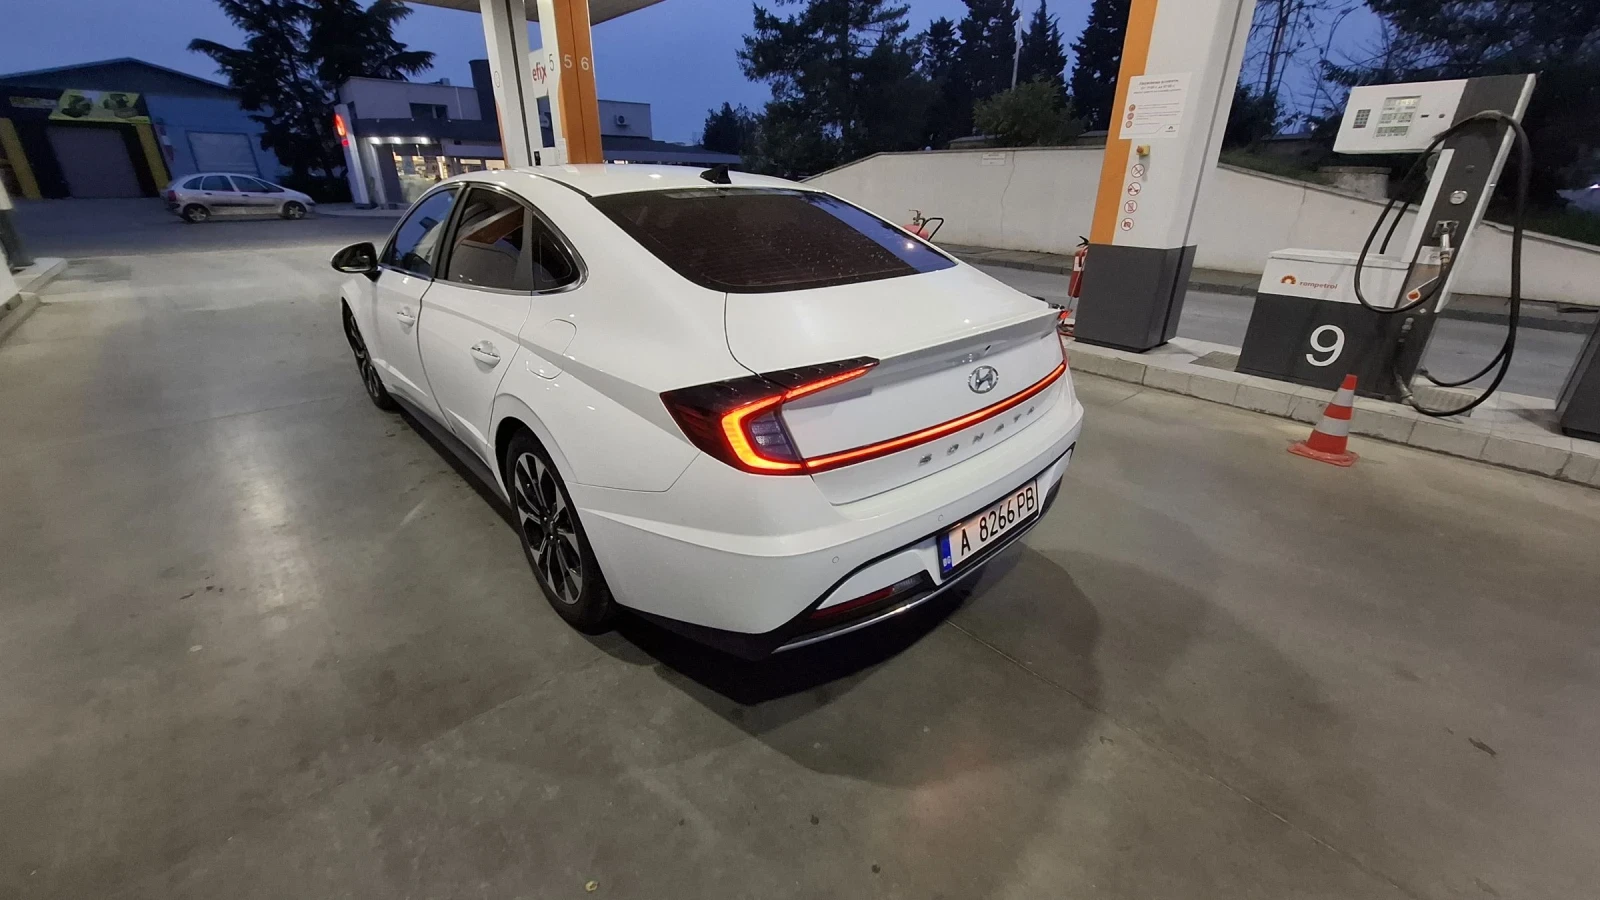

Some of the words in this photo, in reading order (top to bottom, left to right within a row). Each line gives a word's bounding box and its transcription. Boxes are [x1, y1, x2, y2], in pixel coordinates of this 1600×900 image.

[548, 53, 555, 72] 5
[563, 54, 573, 69] 5
[580, 56, 590, 71] 6
[1299, 281, 1338, 290] rompetrol
[1305, 324, 1345, 367] 9
[918, 405, 1035, 466] SONATA
[961, 528, 971, 556] A
